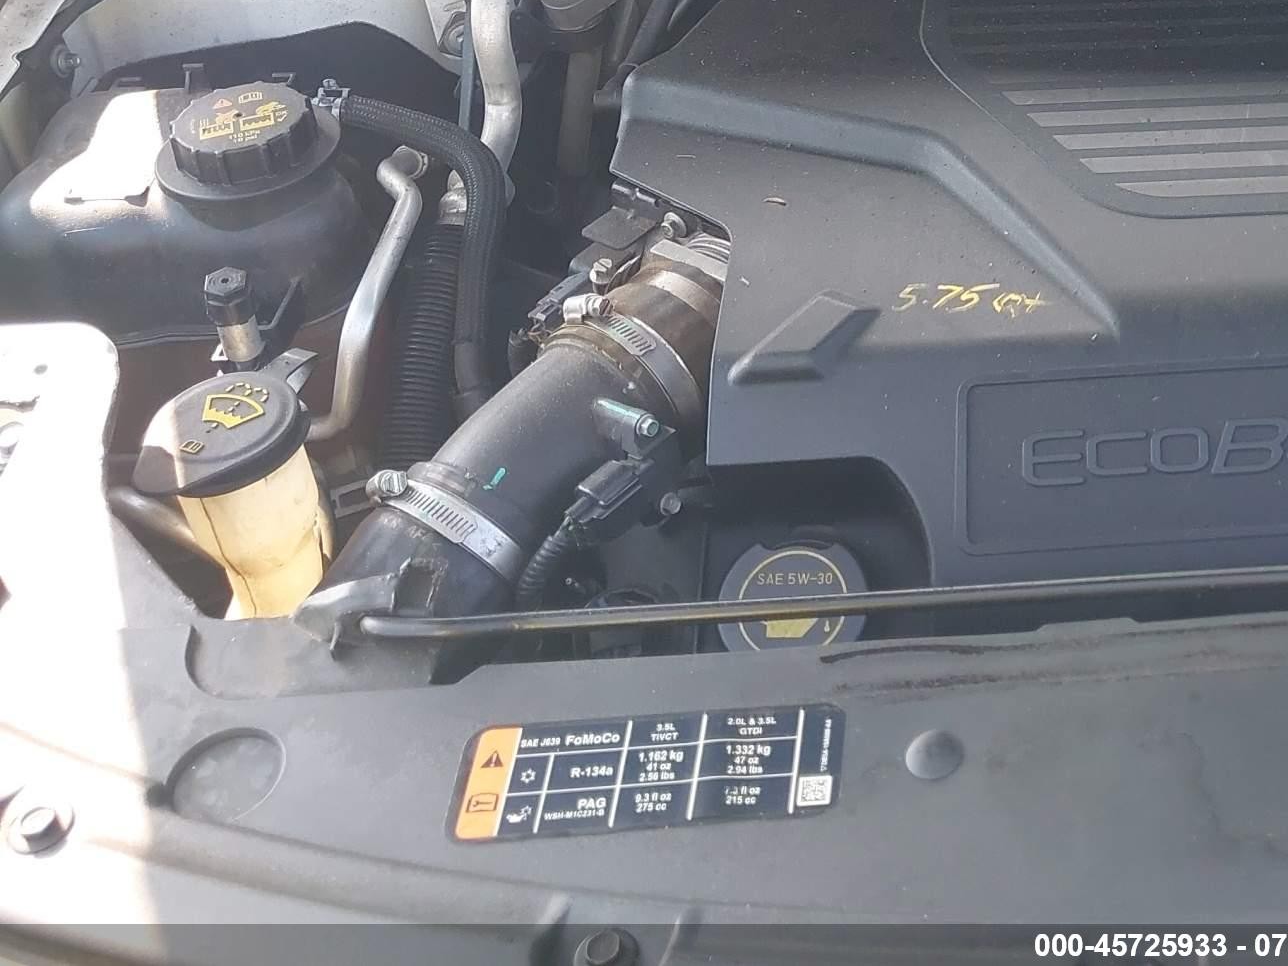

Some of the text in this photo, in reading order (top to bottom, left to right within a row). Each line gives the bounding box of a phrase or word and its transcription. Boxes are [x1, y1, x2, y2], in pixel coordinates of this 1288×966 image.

[892, 283, 1000, 313] 5.75
[757, 572, 833, 585] SAE 5W-30
[727, 717, 746, 726] 2.0L
[757, 716, 776, 725] 3.5L
[656, 723, 676, 732] 3.5L
[520, 732, 620, 748] SAE J639 FoMoCo
[638, 750, 684, 762] 1.162 kg
[725, 745, 771, 756] 1.332 kg
[734, 756, 759, 765] 47 oz
[570, 765, 614, 778] R-134a
[646, 762, 672, 772] 41 oz
[727, 765, 763, 774] 2.94 lbs
[639, 771, 675, 782] 2.56 lbs
[749, 786, 761, 795] oz
[651, 792, 659, 802] fl
[660, 792, 672, 802] oz
[726, 795, 757, 805] 215 cc
[577, 797, 606, 810] PAG
[636, 802, 667, 814] 275 cc
